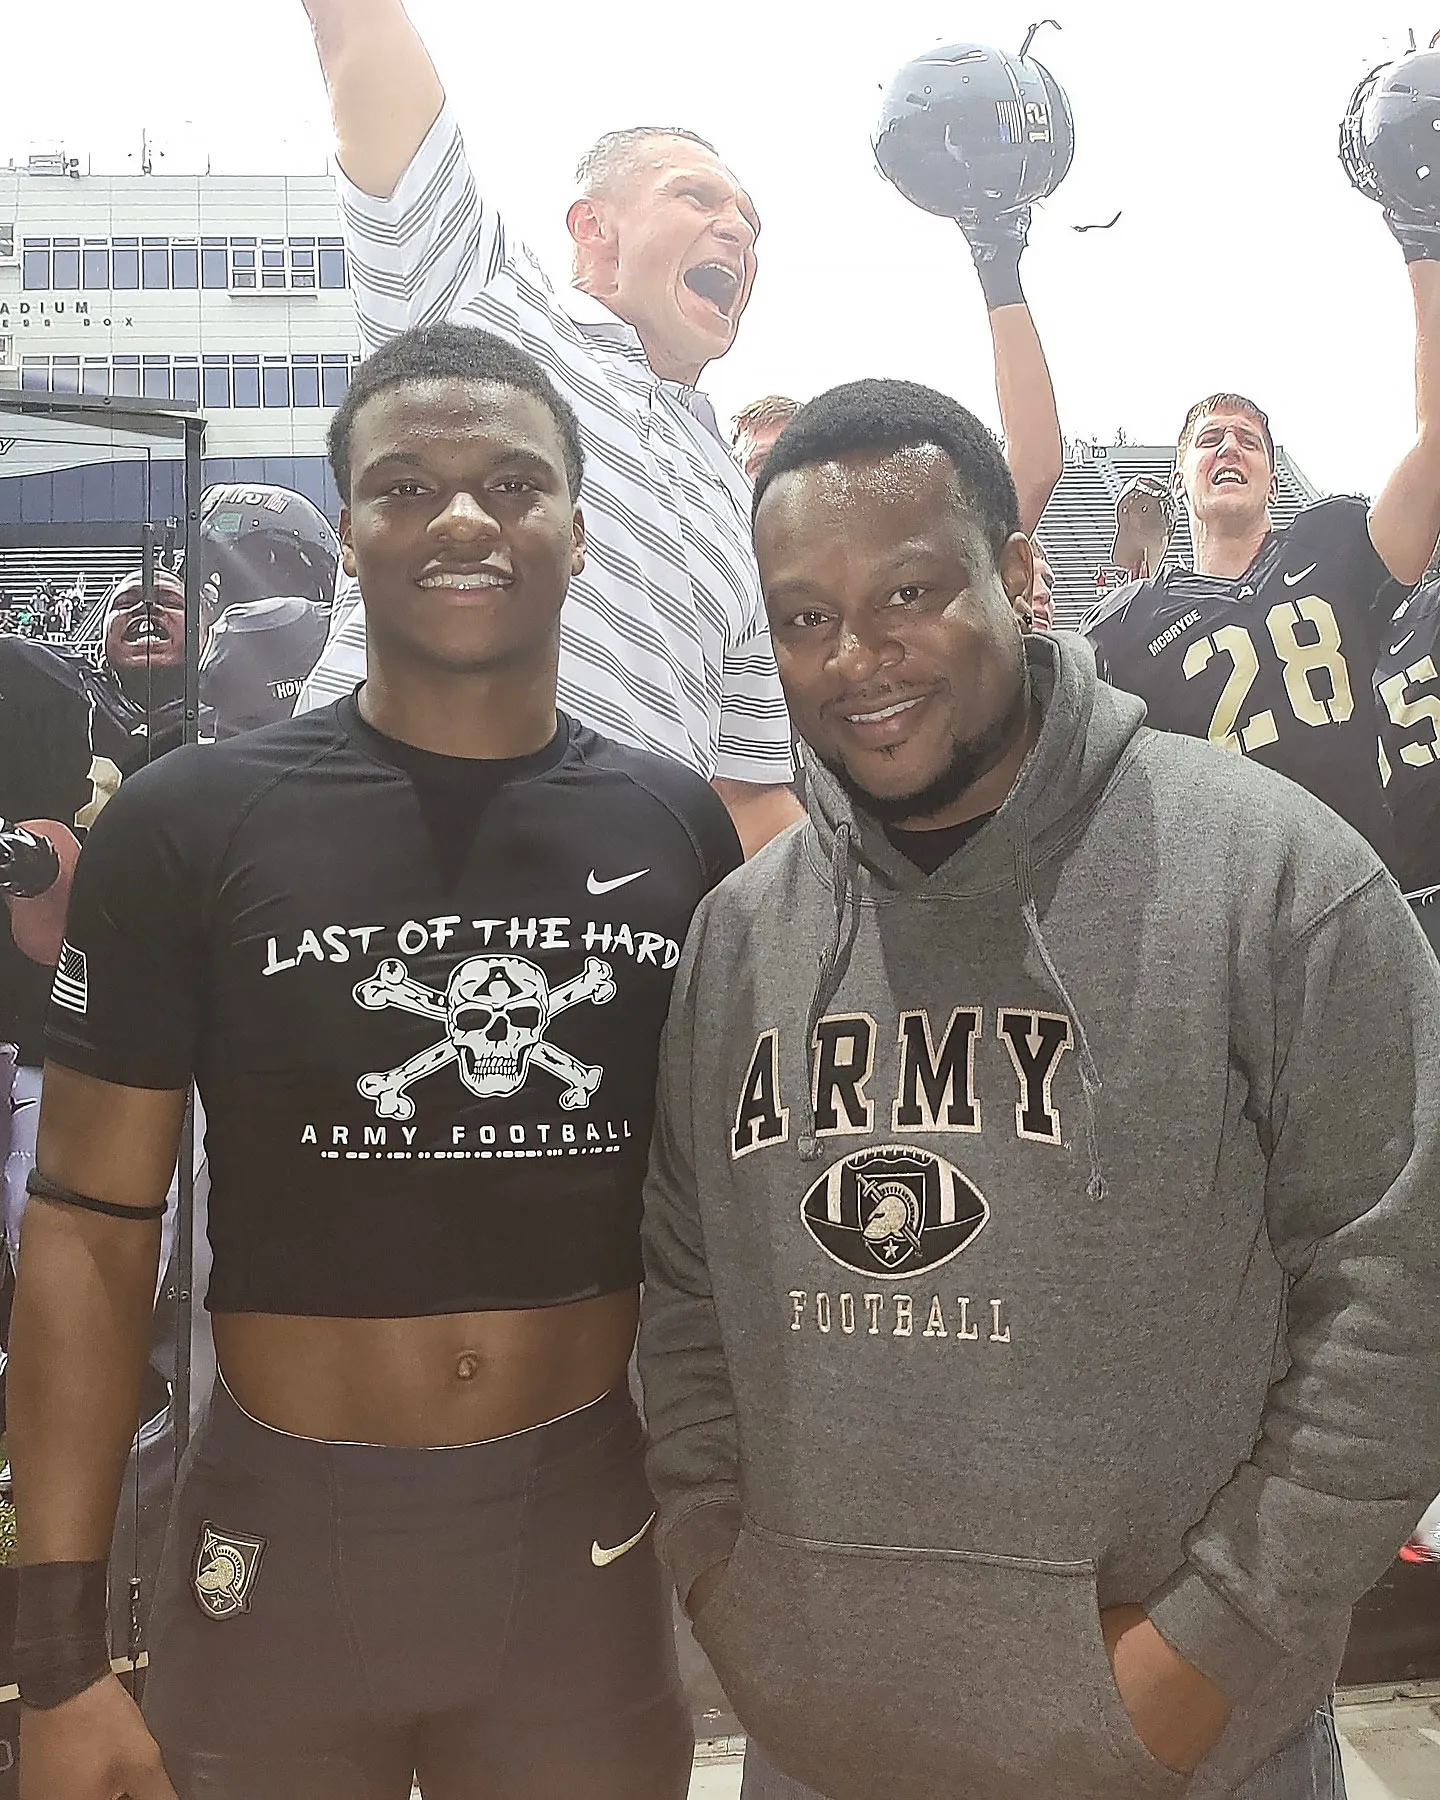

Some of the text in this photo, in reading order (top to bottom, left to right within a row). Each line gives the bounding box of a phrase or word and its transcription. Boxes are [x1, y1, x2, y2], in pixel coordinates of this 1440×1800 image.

[1147, 608, 1202, 657] MCBRYDE
[1181, 595, 1354, 755] 28
[262, 915, 681, 976] LAST OF THE HARD
[731, 1006, 1075, 1161] ARMY
[301, 1120, 632, 1145] ARMY FOOTBALL
[788, 1290, 1011, 1343] FOOTBALL
